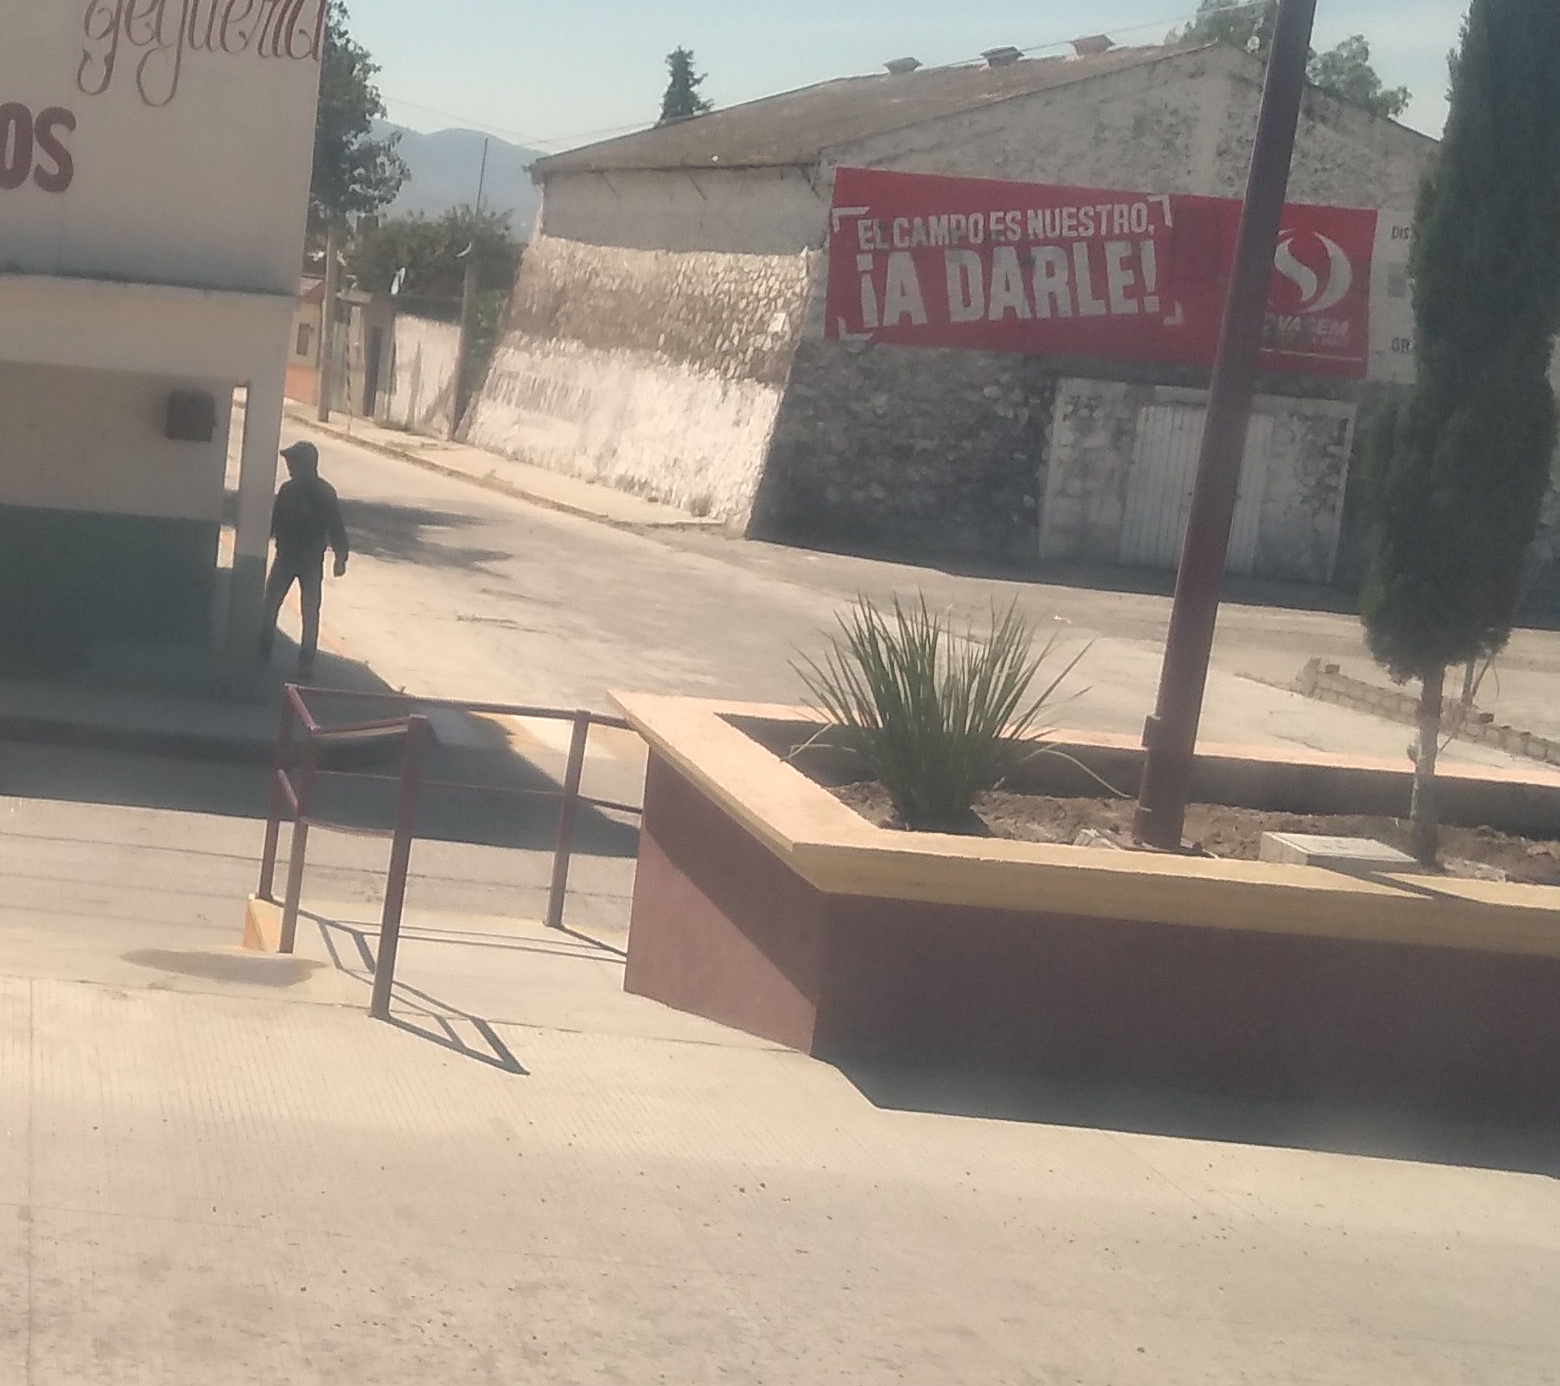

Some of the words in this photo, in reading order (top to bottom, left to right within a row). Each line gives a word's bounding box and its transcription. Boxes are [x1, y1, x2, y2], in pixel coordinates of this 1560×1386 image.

[857, 219, 889, 250] EL
[893, 213, 984, 248] CAMPO
[990, 211, 1022, 242] ES
[1027, 202, 1155, 240] NUESTRO,
[856, 250, 928, 328] ¡A
[945, 239, 1160, 323] DARLE!
